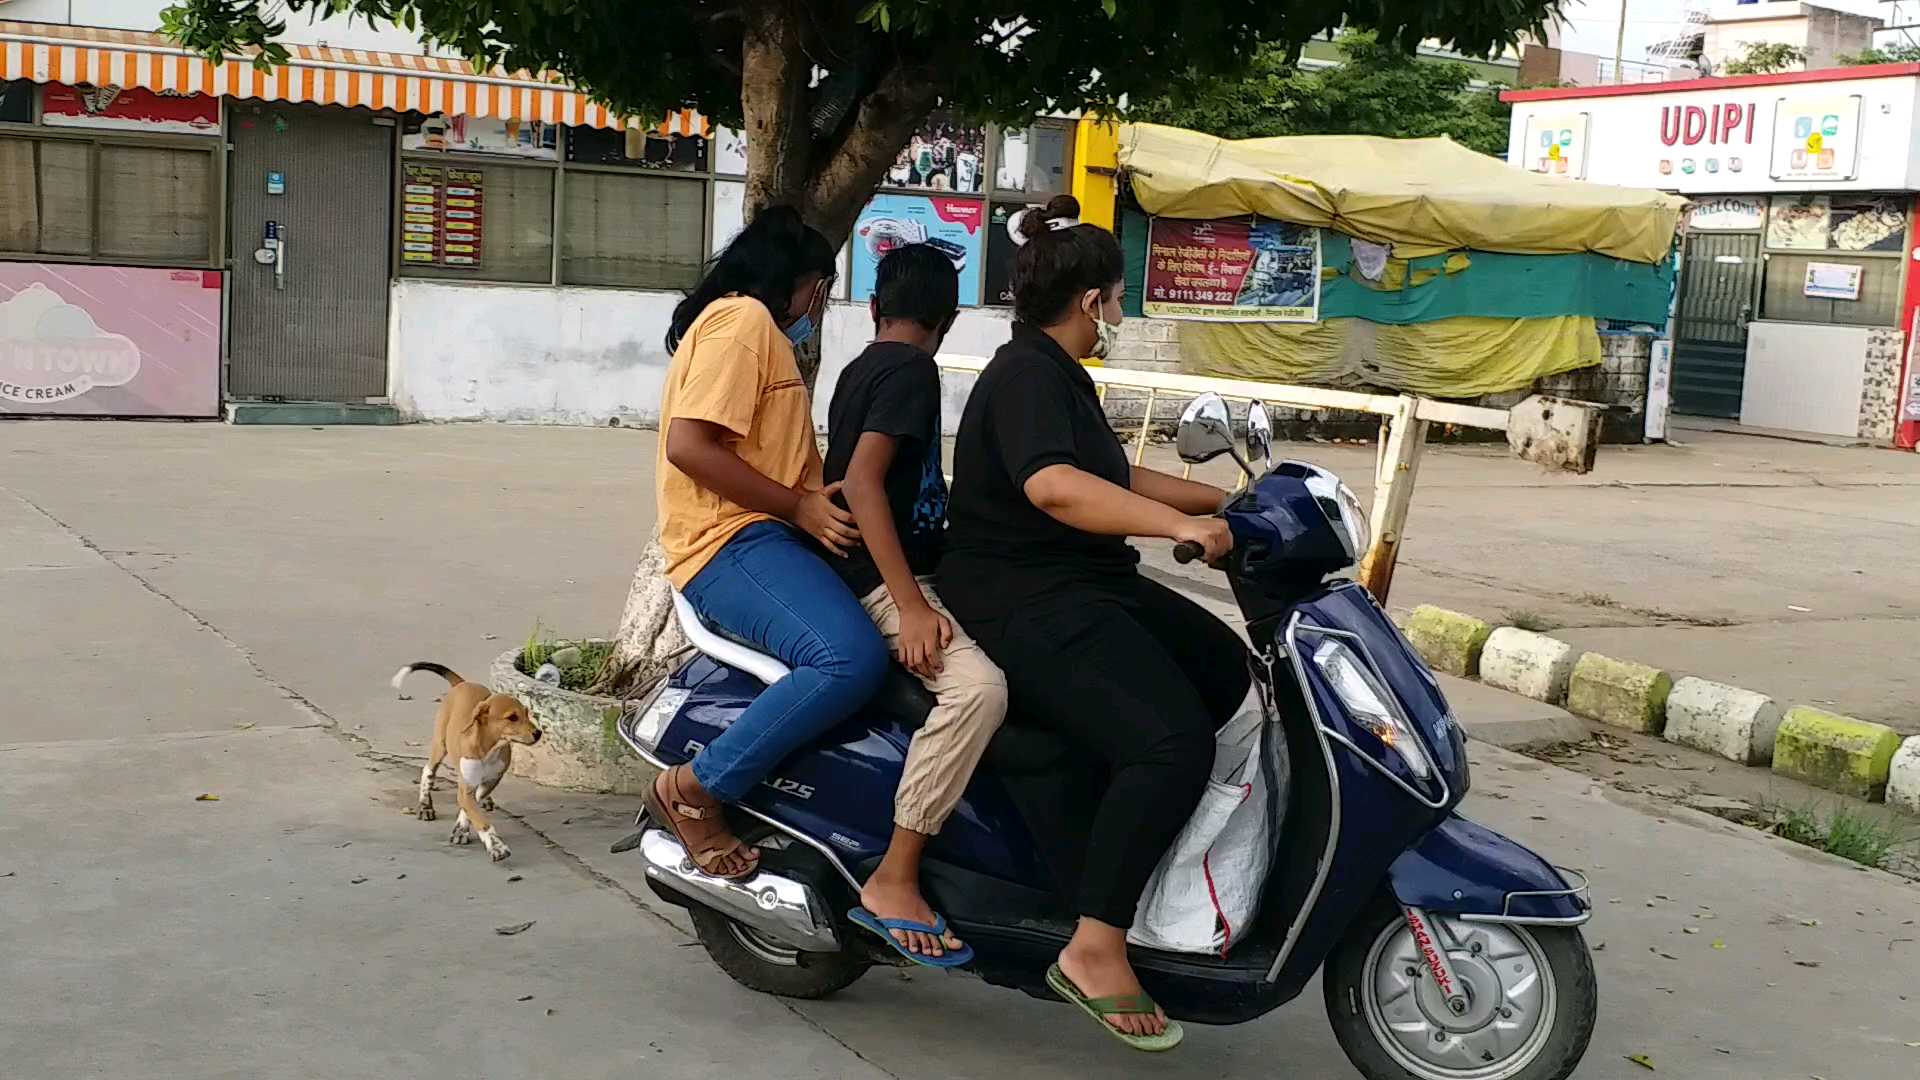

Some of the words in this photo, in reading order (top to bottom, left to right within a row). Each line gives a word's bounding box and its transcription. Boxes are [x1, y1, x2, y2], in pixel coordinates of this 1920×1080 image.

[1660, 103, 1756, 147] UDIPI
[1697, 198, 1756, 216] WELCOME
[1169, 290, 1193, 300] 9111
[1196, 291, 1213, 301] 349
[1215, 291, 1232, 302] 222
[25, 383, 76, 399] CREAM
[772, 777, 815, 800] 125
